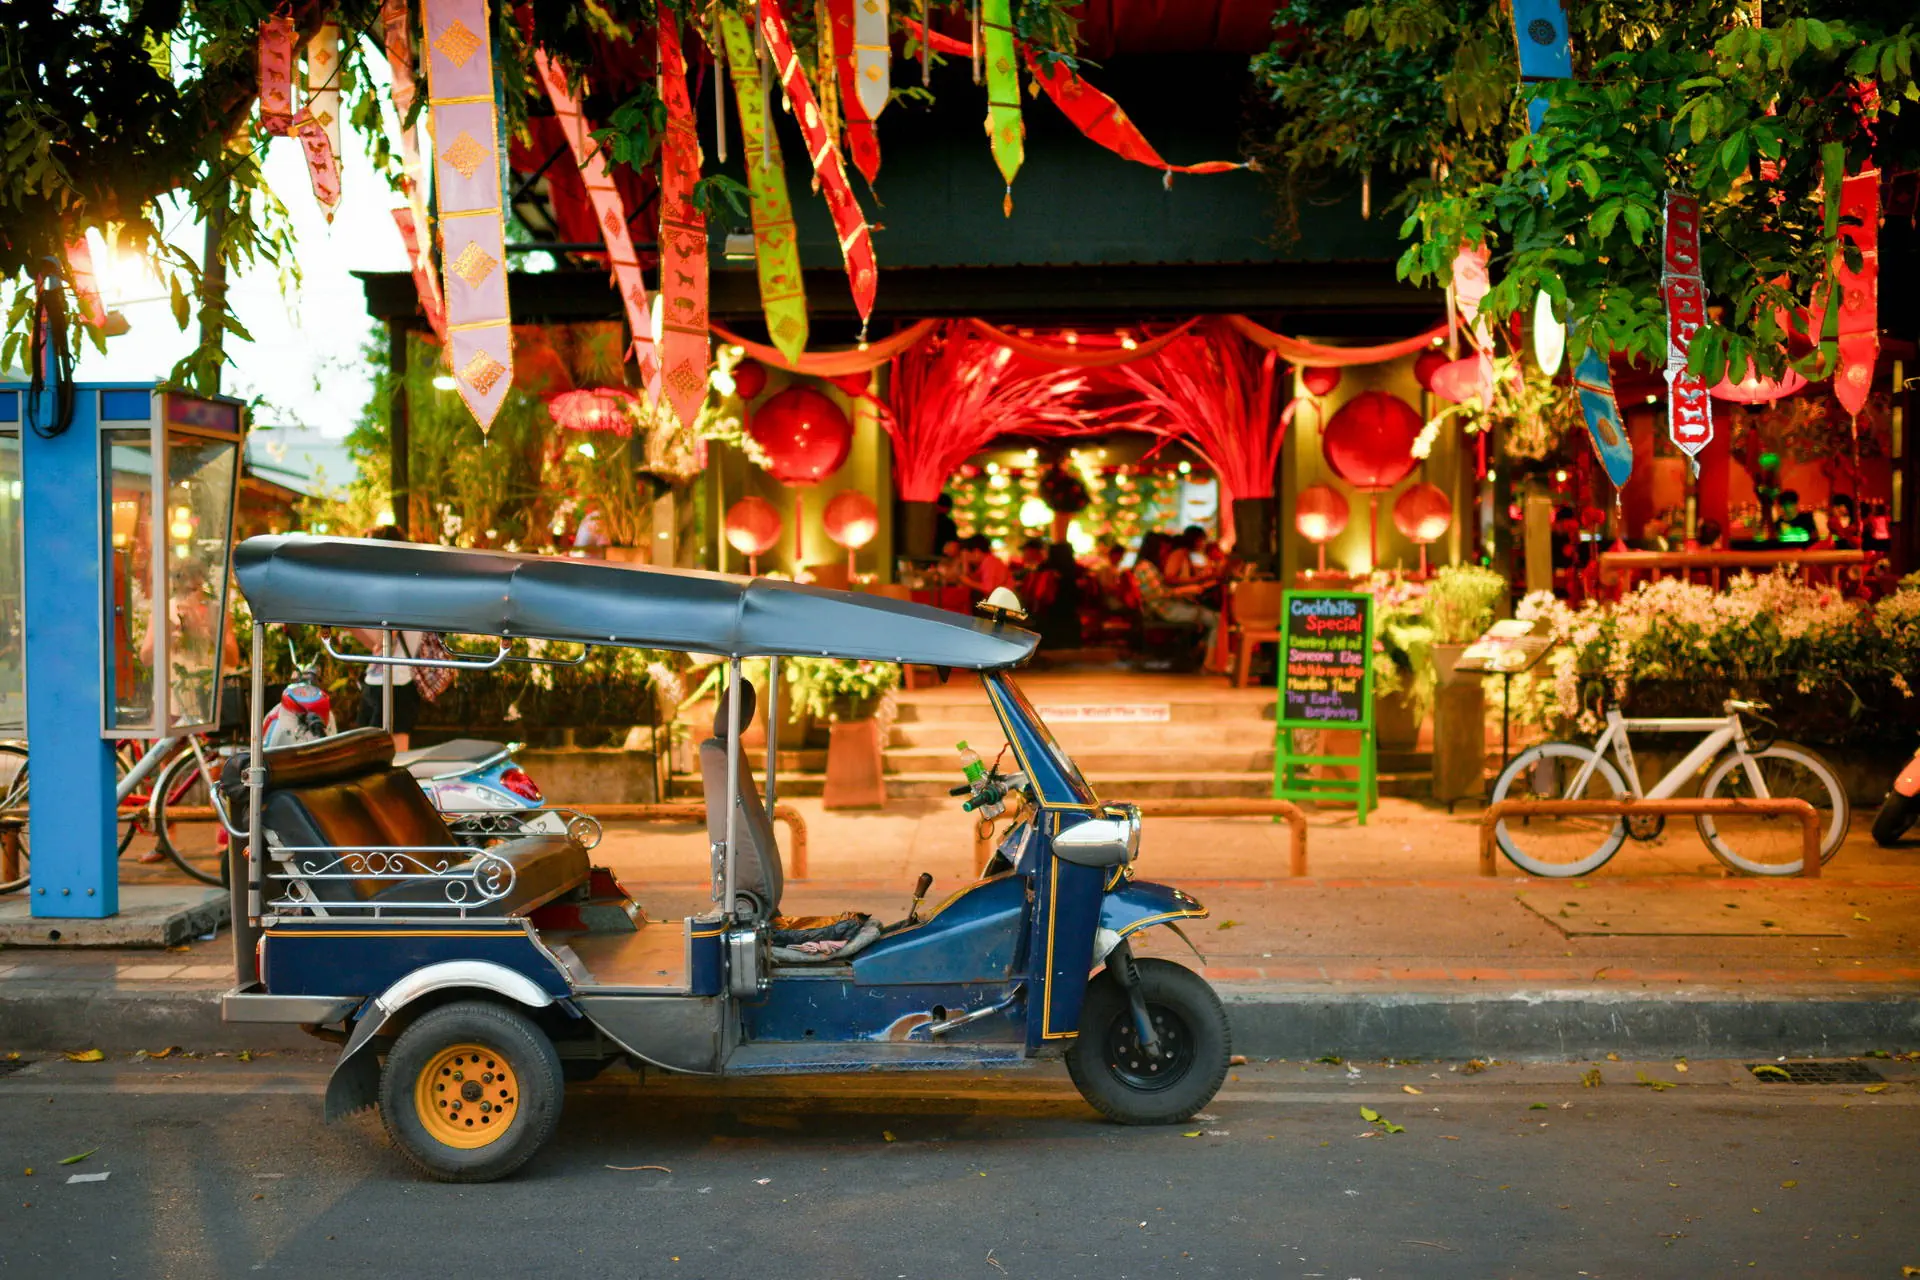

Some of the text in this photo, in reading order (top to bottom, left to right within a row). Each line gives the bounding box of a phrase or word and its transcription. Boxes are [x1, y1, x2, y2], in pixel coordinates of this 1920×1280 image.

[1306, 613, 1362, 635] Special
[1289, 648, 1363, 664] Someone Else
[1286, 690, 1342, 706] The Earth
